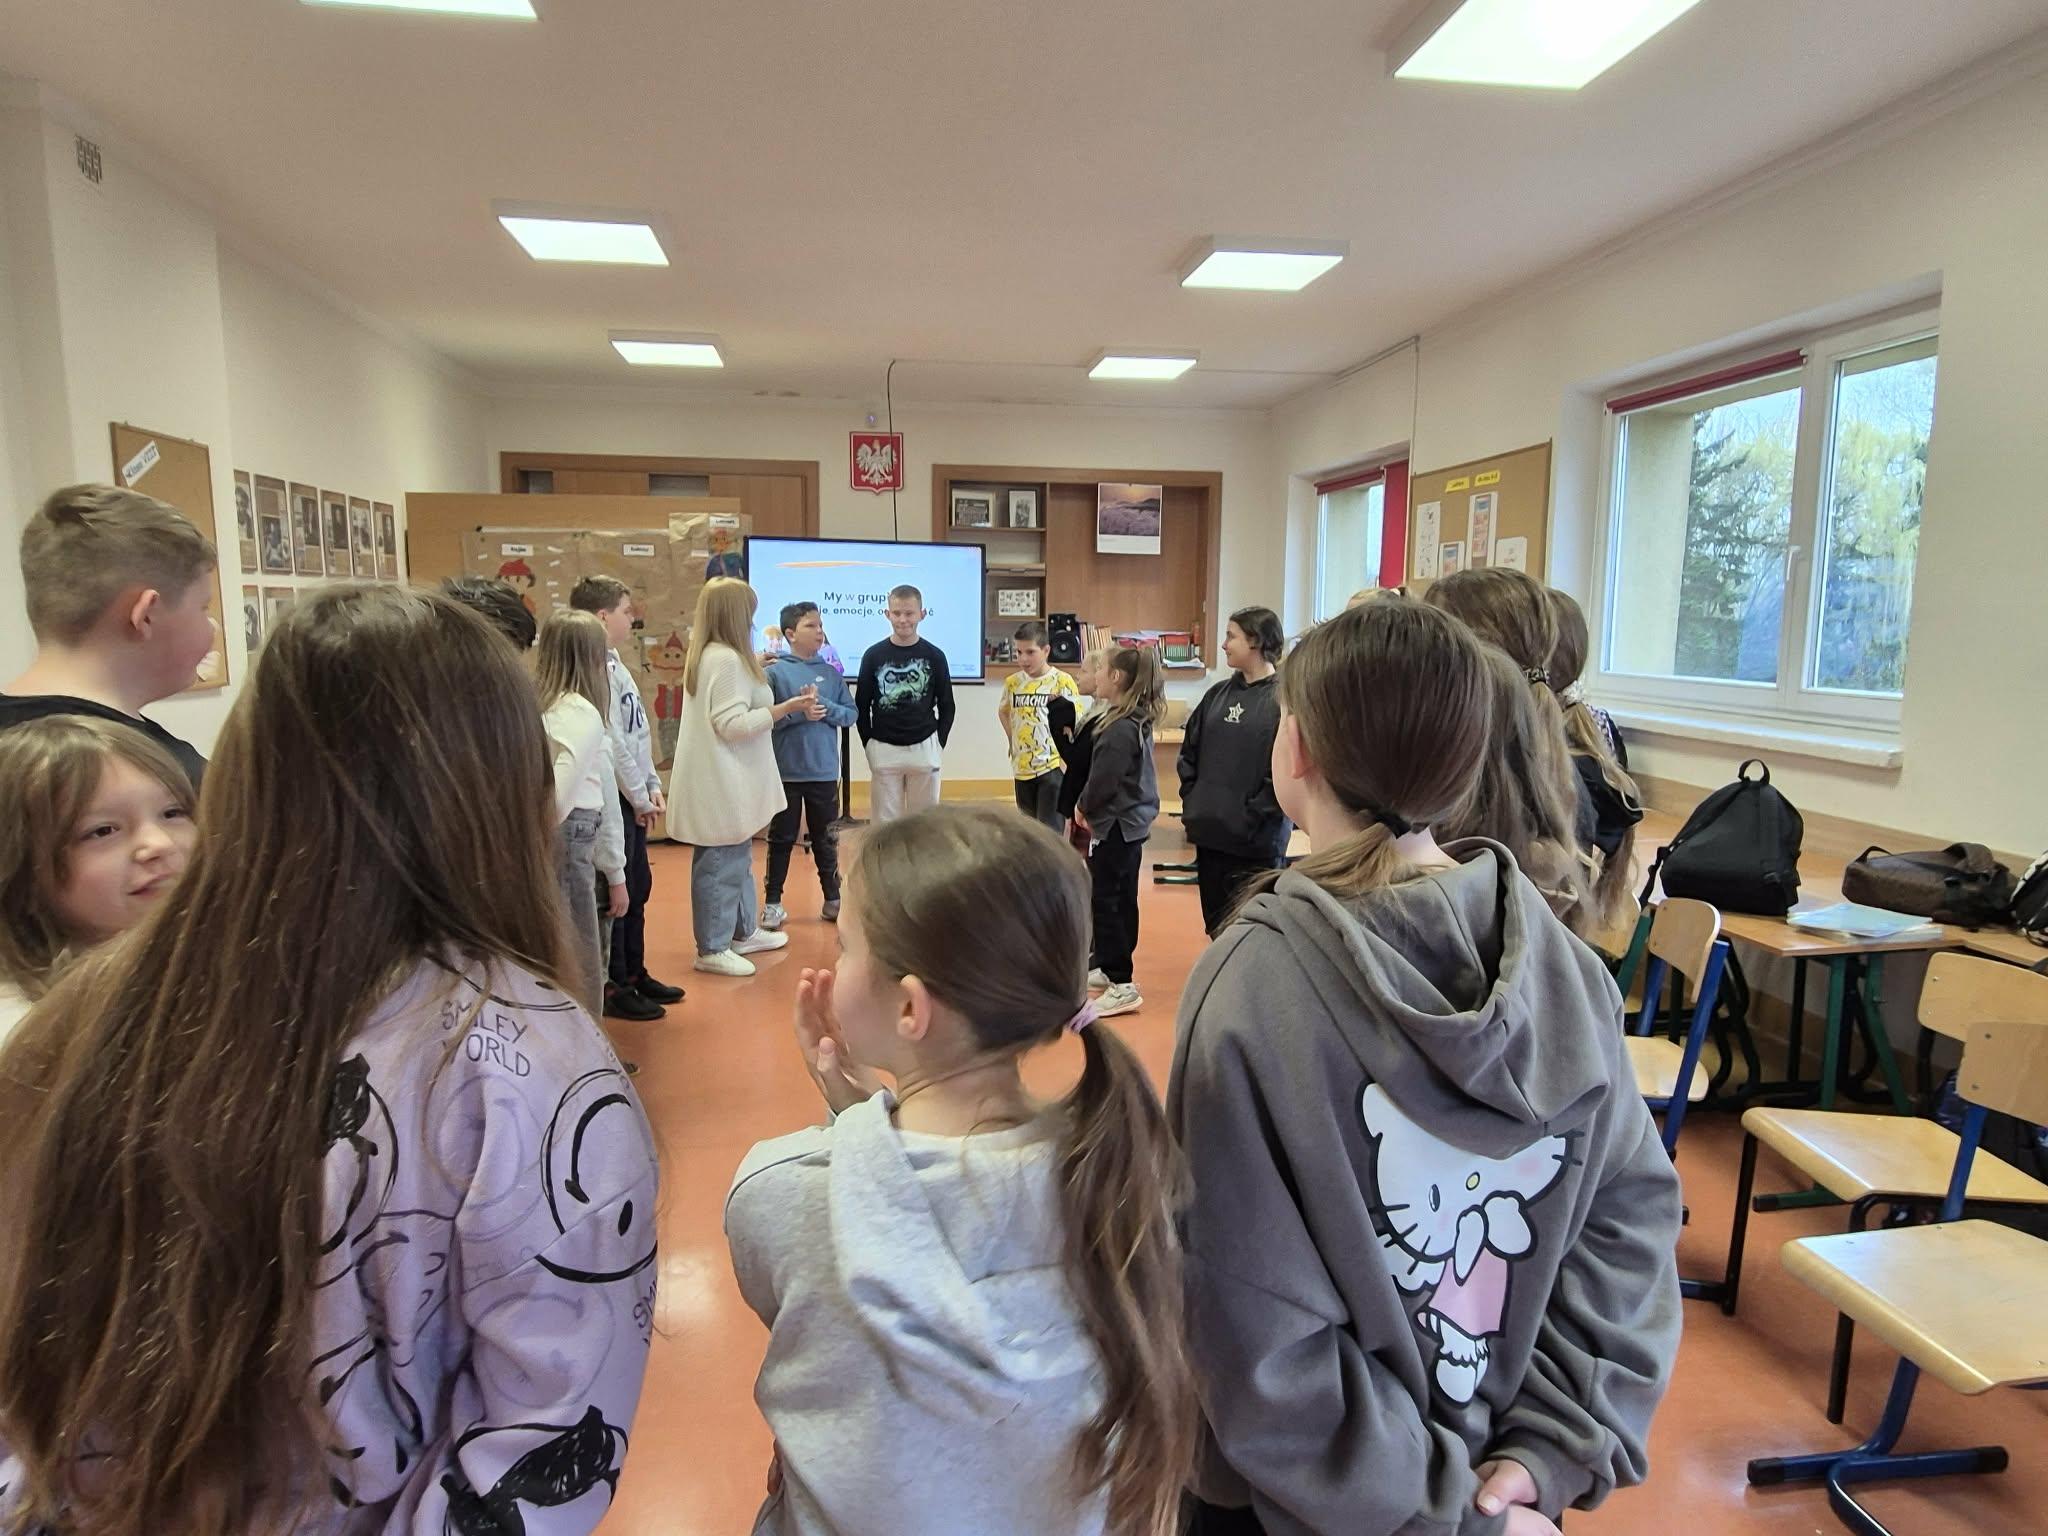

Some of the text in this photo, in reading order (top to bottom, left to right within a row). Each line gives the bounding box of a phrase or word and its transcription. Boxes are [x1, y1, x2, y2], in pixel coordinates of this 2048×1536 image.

[824, 591, 842, 604] My
[1015, 695, 1049, 707] PIKACHU
[441, 1032, 531, 1077] ORLD
